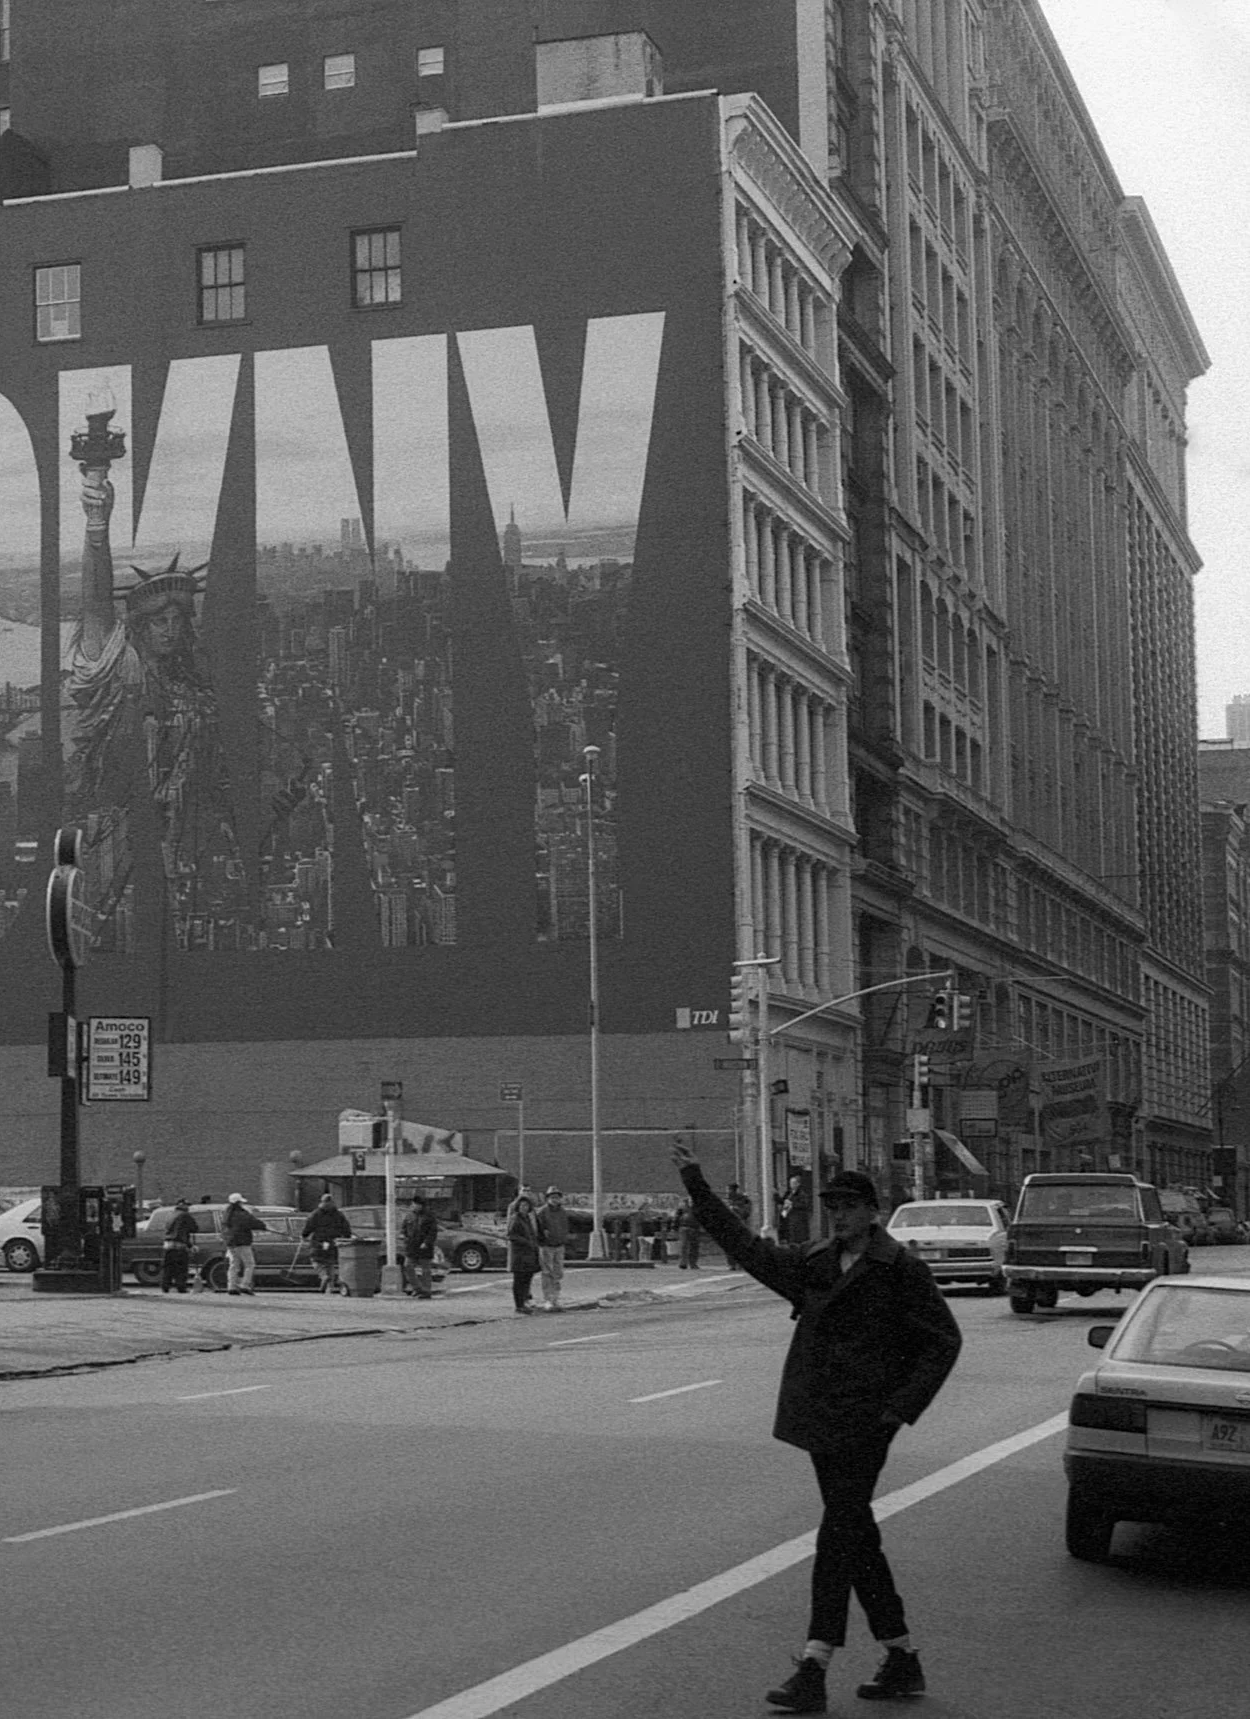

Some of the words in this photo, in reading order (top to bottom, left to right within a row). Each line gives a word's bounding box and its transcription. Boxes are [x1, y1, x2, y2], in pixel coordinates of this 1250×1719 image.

[692, 1010, 719, 1024] TDI
[95, 1021, 145, 1032] Amoco
[119, 1034, 141, 1049] 129
[118, 1052, 140, 1067] 145
[119, 1069, 141, 1085] 149
